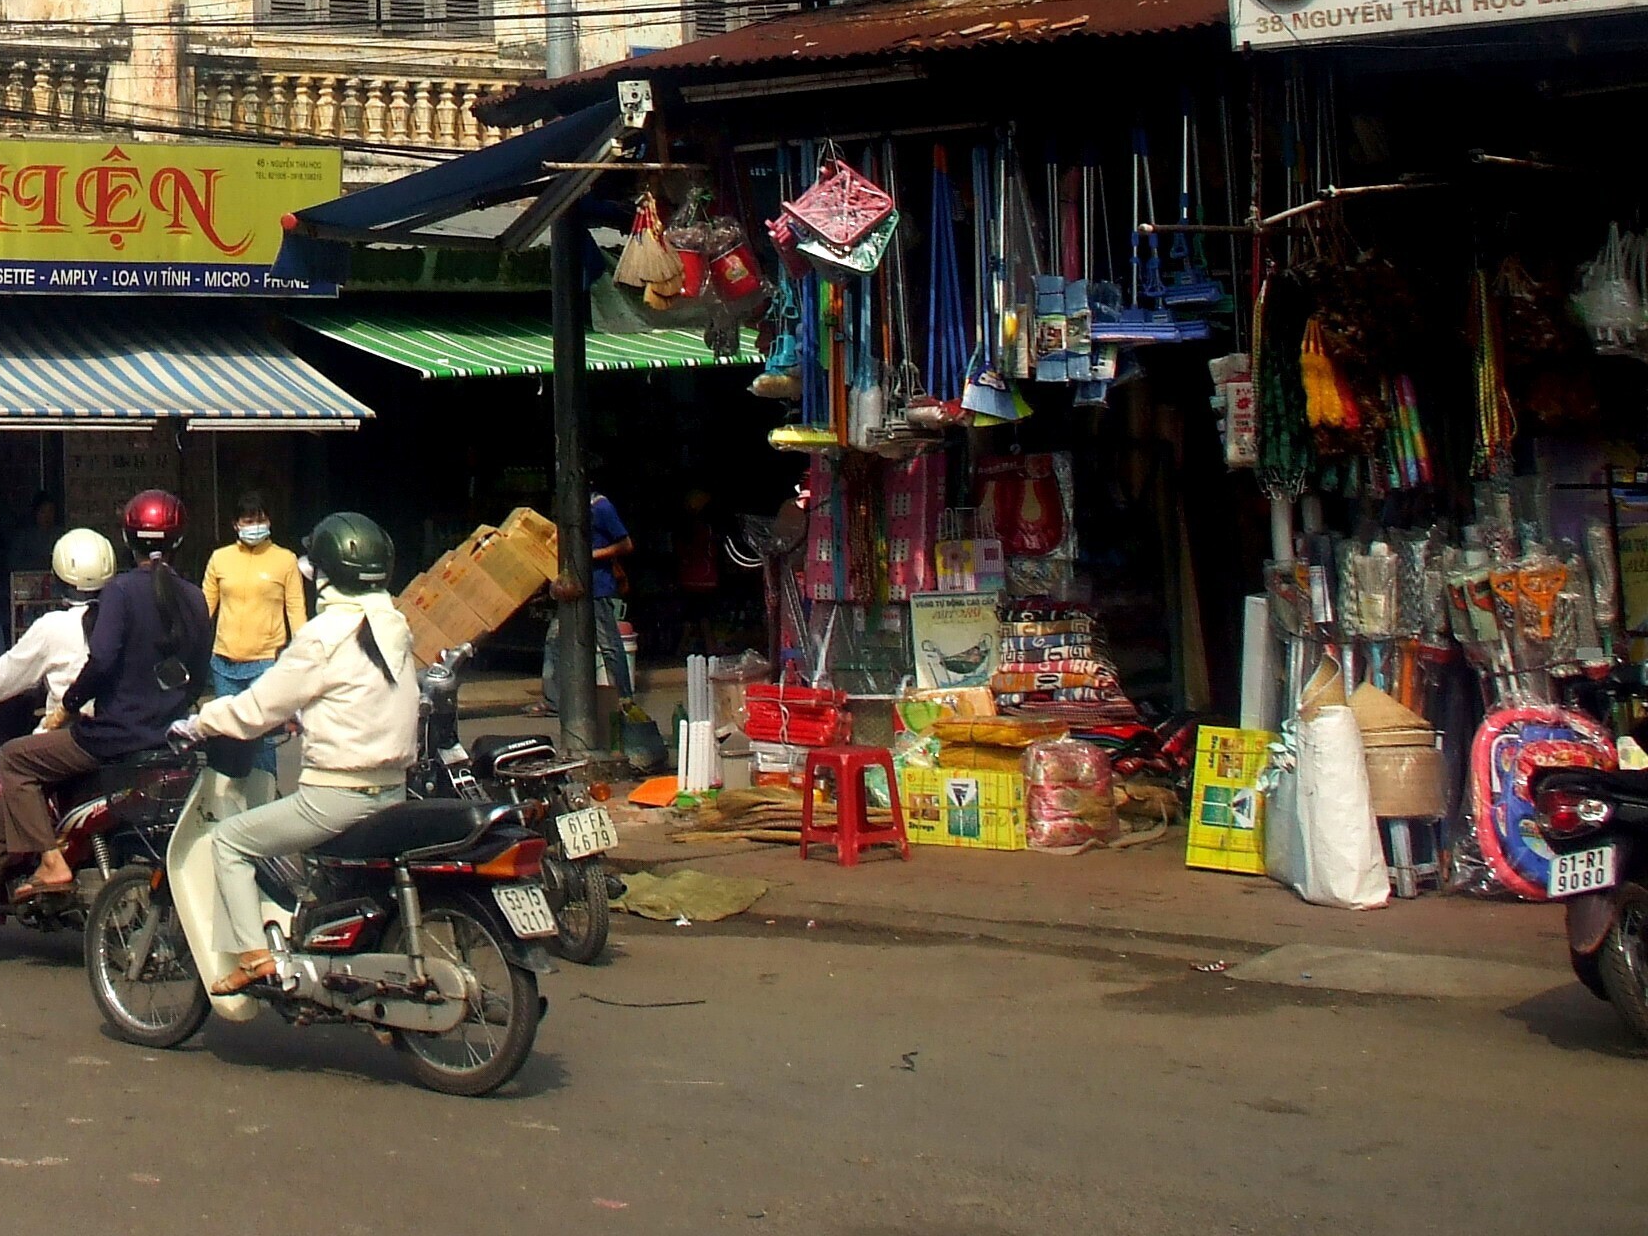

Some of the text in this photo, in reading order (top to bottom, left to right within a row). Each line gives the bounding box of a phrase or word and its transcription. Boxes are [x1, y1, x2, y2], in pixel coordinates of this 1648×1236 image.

[1256, 14, 1285, 35] 38
[49, 269, 98, 286] AMPLY
[112, 269, 140, 286] LOA
[143, 270, 158, 286] VI
[160, 265, 191, 287] TÍNH
[204, 271, 250, 288] MICRO
[566, 809, 606, 835] 61-FA
[571, 830, 611, 854] 4679
[1557, 849, 1605, 875] 61-R1
[1557, 868, 1605, 893] 9080
